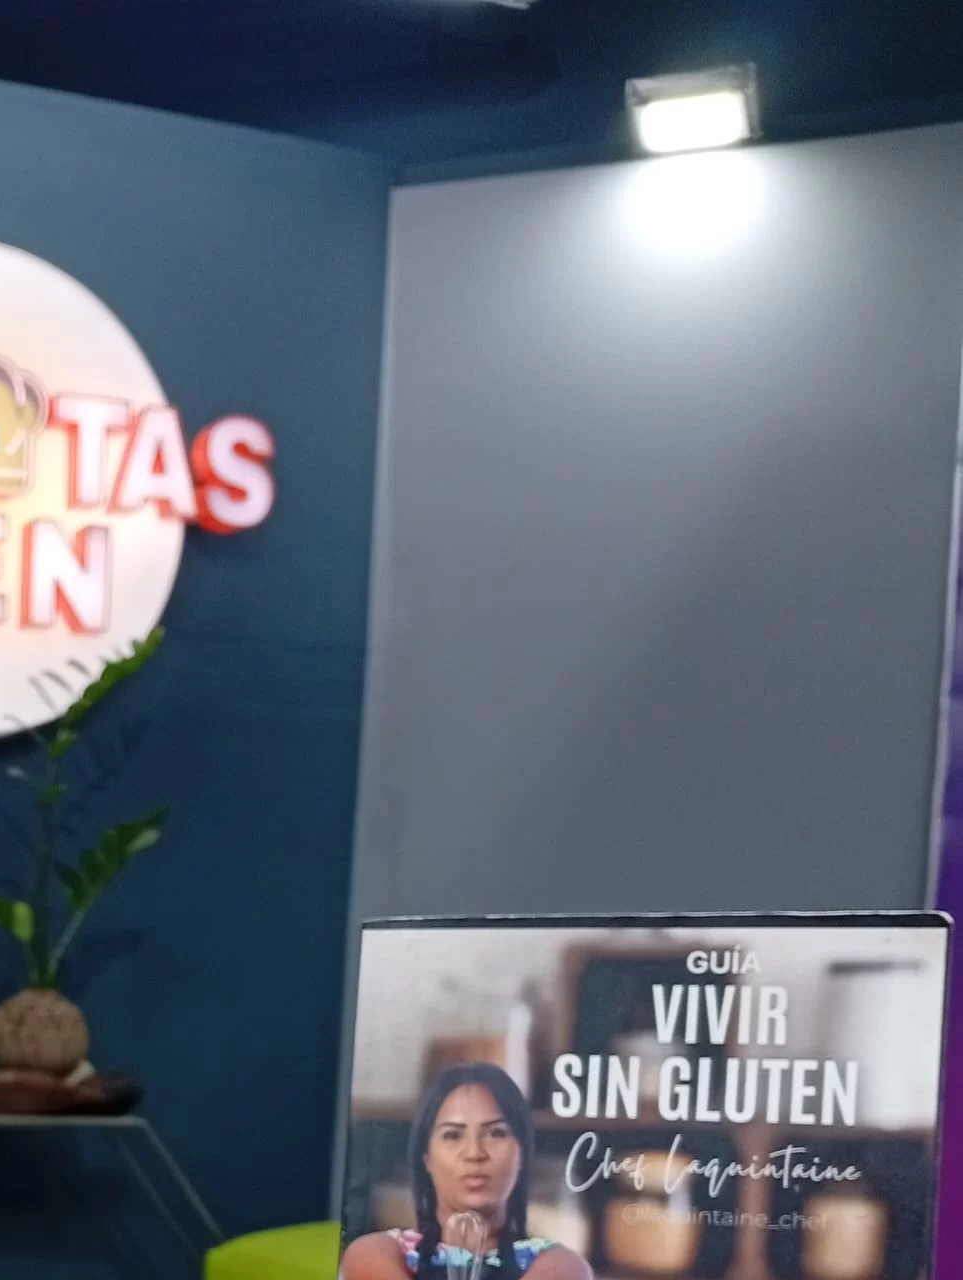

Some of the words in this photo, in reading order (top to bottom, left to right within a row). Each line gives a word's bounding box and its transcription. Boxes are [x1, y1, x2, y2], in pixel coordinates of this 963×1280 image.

[686, 944, 762, 975] GUÍA
[652, 983, 788, 1046] VIVIR
[551, 1053, 641, 1119] SIN
[658, 1056, 859, 1127] GLUTEN
[564, 1131, 649, 1193] Chef
[662, 1133, 863, 1198] Laquintaine
